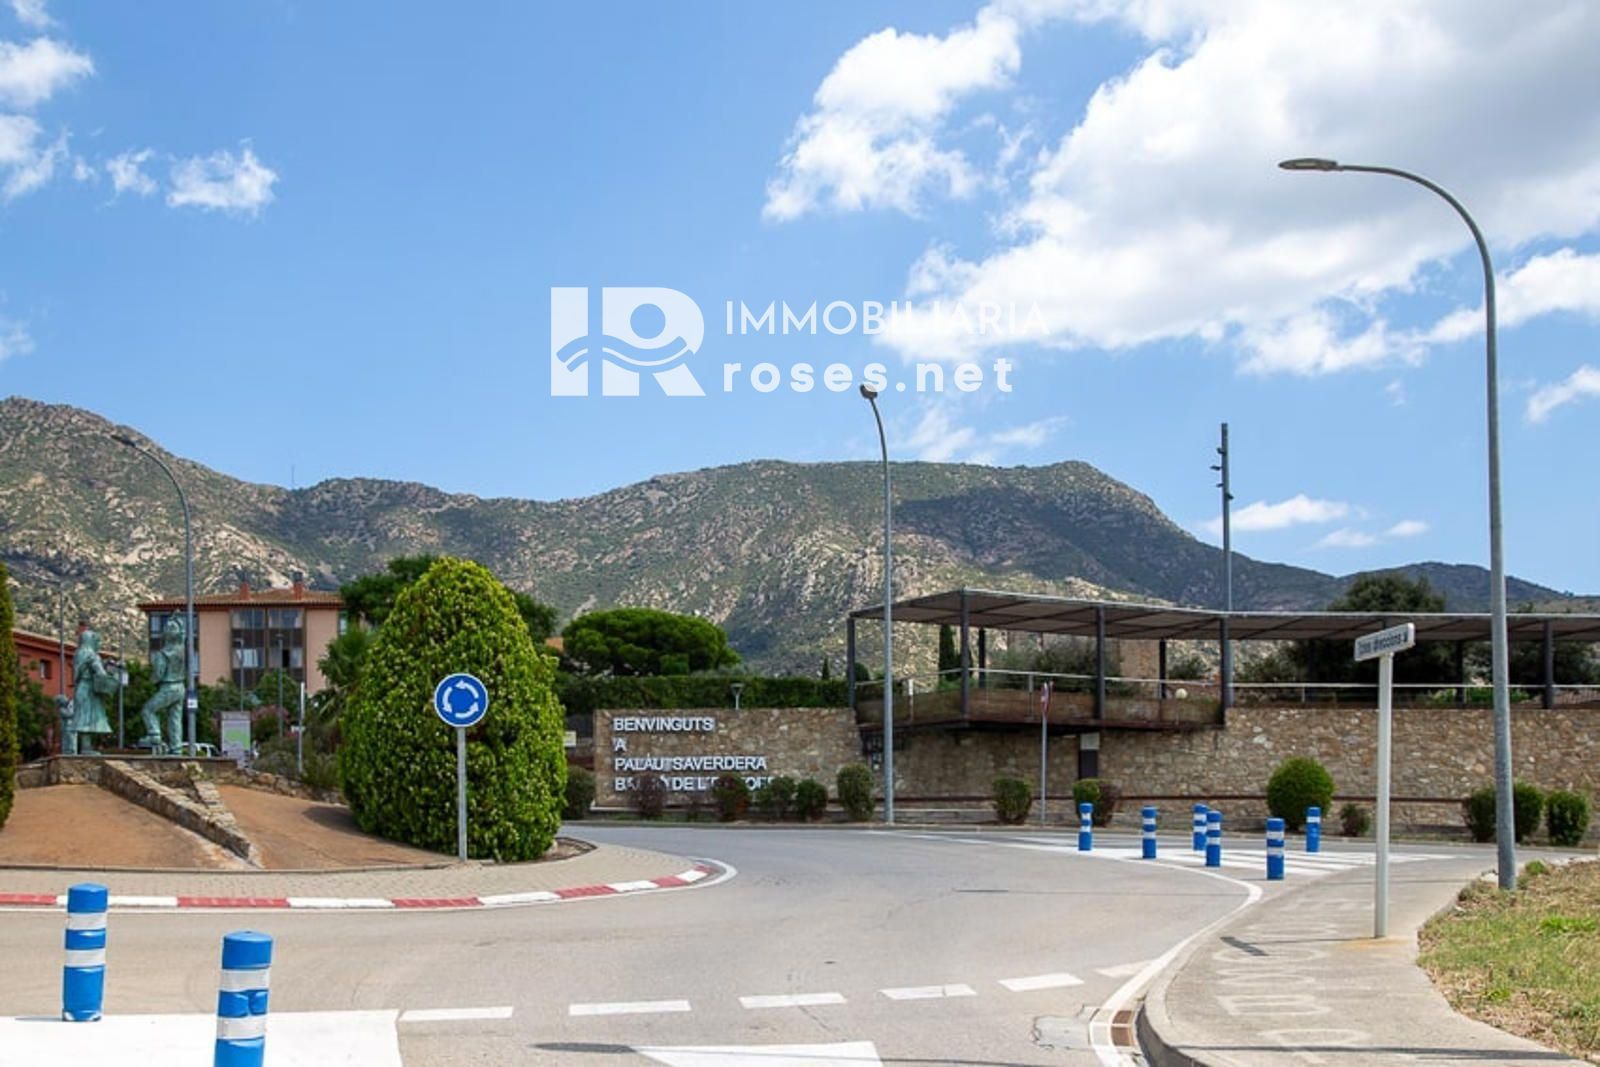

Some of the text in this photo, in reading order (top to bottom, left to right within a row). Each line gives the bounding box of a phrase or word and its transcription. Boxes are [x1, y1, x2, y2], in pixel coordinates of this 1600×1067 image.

[613, 716, 715, 731] BENVINGUTS
[614, 737, 627, 752] A
[671, 776, 694, 791] DE
